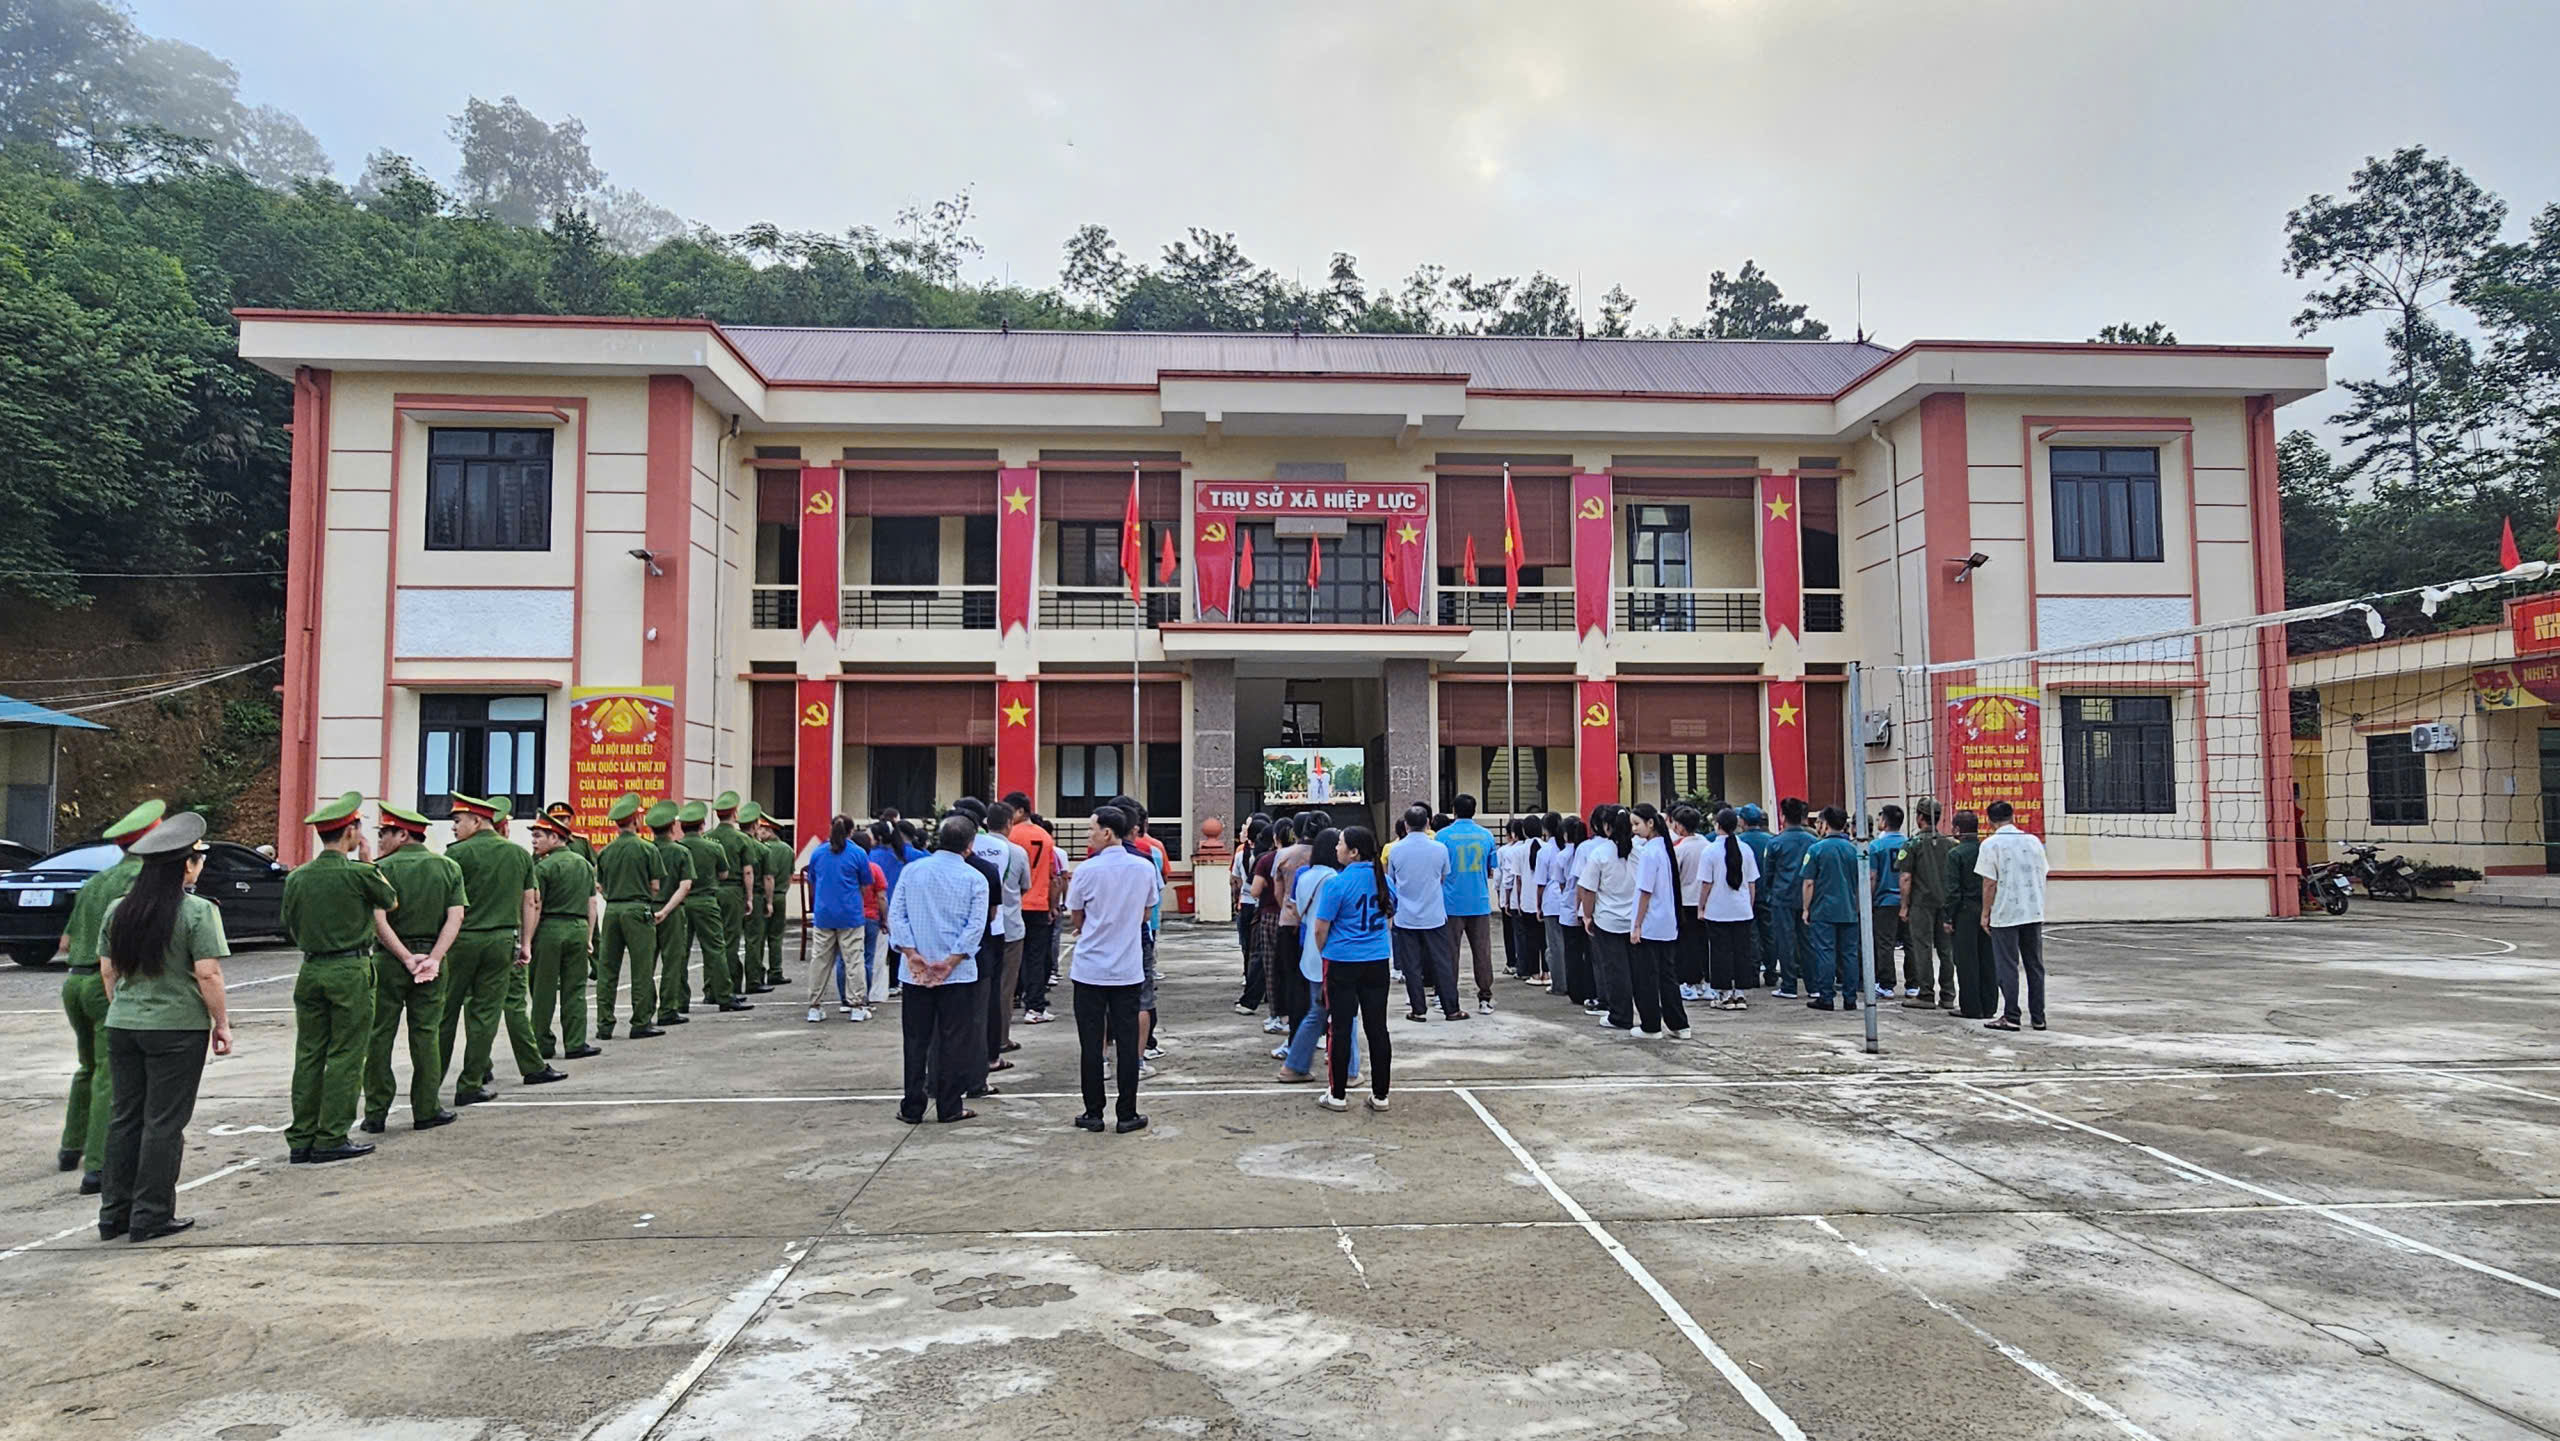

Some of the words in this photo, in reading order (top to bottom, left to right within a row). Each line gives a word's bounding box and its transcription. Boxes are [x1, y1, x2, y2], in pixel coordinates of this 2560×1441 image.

[1209, 491, 1250, 511] TRỤ
[1255, 485, 1285, 508] SỞ
[1290, 489, 1319, 508] XÃ
[1323, 489, 1371, 512] HIỆP
[1377, 491, 1416, 512] LỰC
[2523, 663, 2559, 682] NHIỆT
[576, 760, 597, 773] TOÀN
[598, 758, 619, 775] QUỐC
[653, 761, 667, 773] XIV
[579, 776, 596, 791] CỦA
[1030, 840, 1044, 869] 7
[1457, 842, 1482, 872] 12
